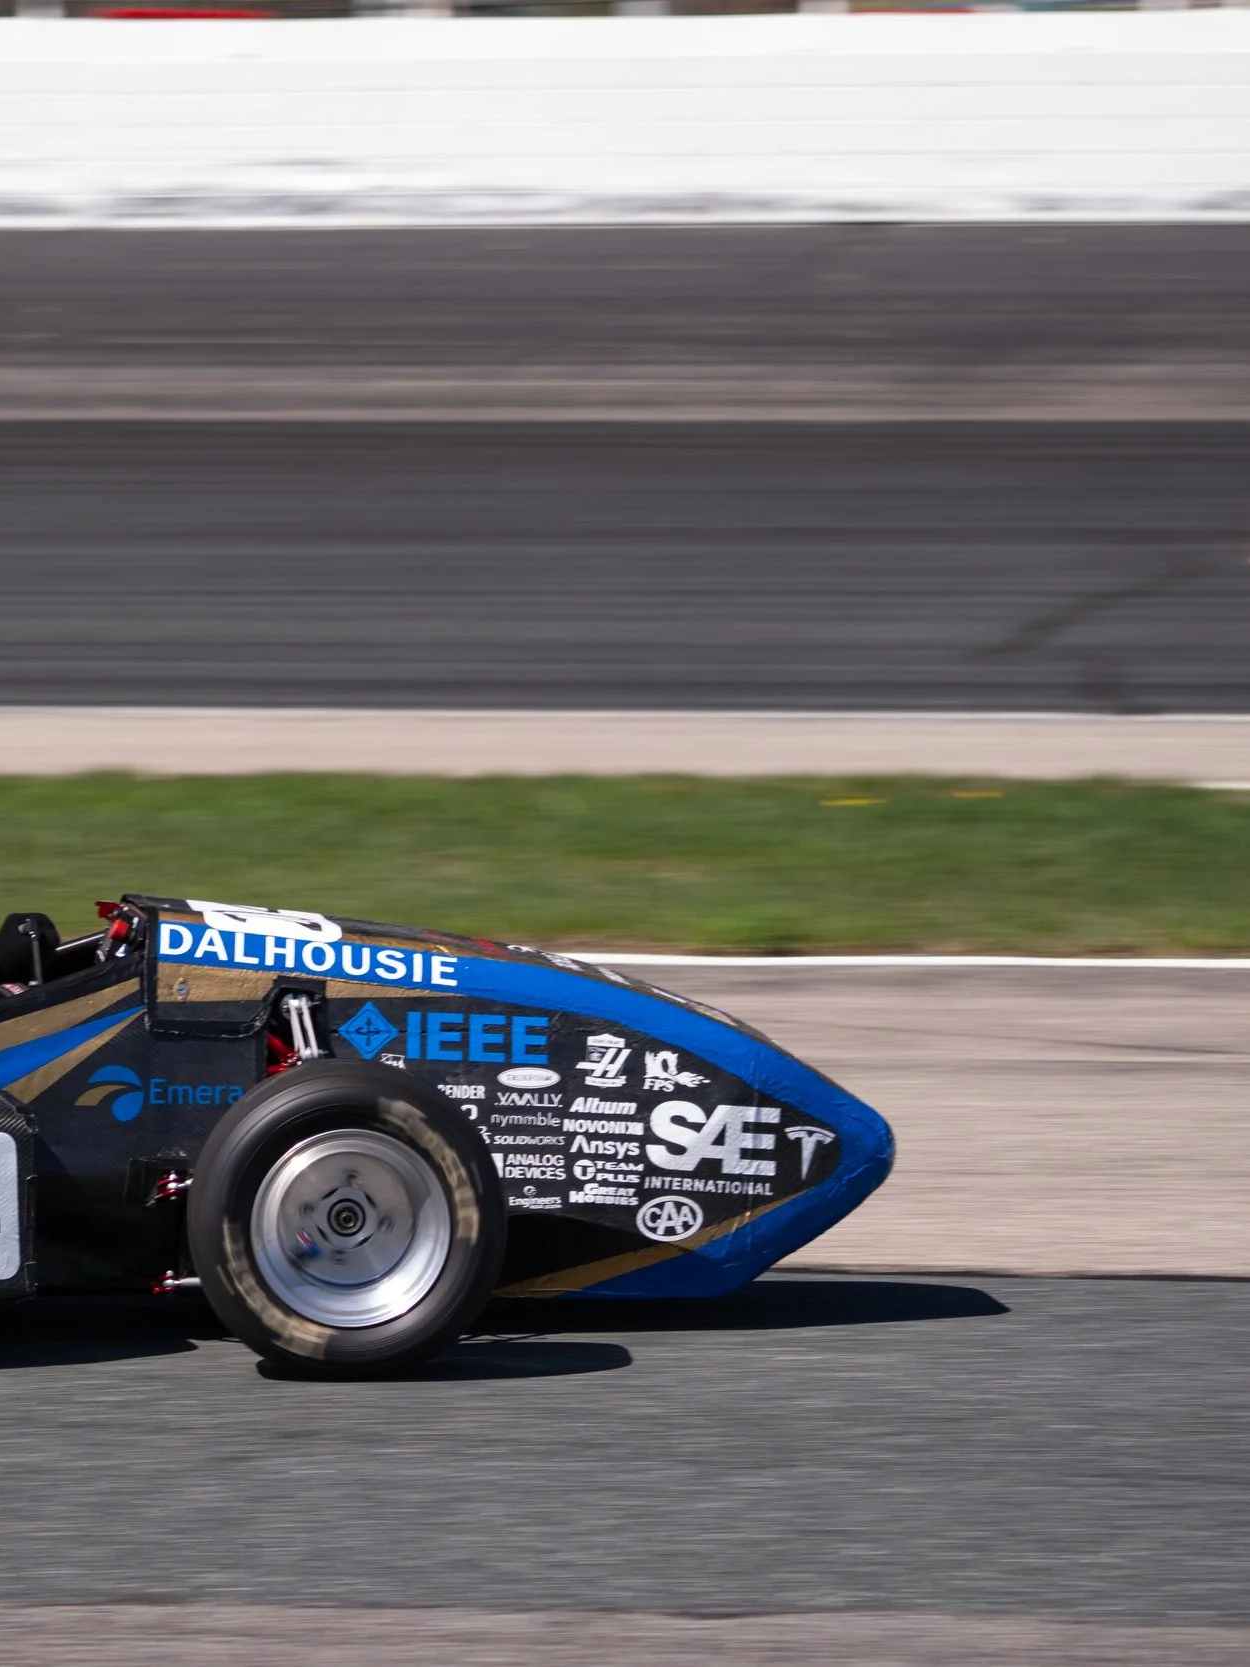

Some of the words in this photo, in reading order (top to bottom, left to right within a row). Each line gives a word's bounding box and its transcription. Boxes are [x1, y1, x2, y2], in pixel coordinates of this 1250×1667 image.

[158, 923, 458, 987] DALHOUSIE
[406, 1011, 549, 1065] IEEE
[150, 1078, 243, 1105] Emera
[643, 1078, 675, 1092] FPS
[568, 1096, 638, 1115] Altium
[490, 1111, 562, 1127] nymmble
[562, 1119, 645, 1136] NOVONIX
[493, 1135, 566, 1145] SOLIDWORKS
[569, 1134, 640, 1159] Ansys
[645, 1100, 782, 1177] SAE
[505, 1153, 565, 1166] ANALOG
[595, 1160, 645, 1172] TEAM
[505, 1166, 567, 1180] DEVICES
[596, 1172, 641, 1184] PLUS
[644, 1175, 774, 1197] INTERNATIONAL
[644, 1201, 696, 1235] CAA
